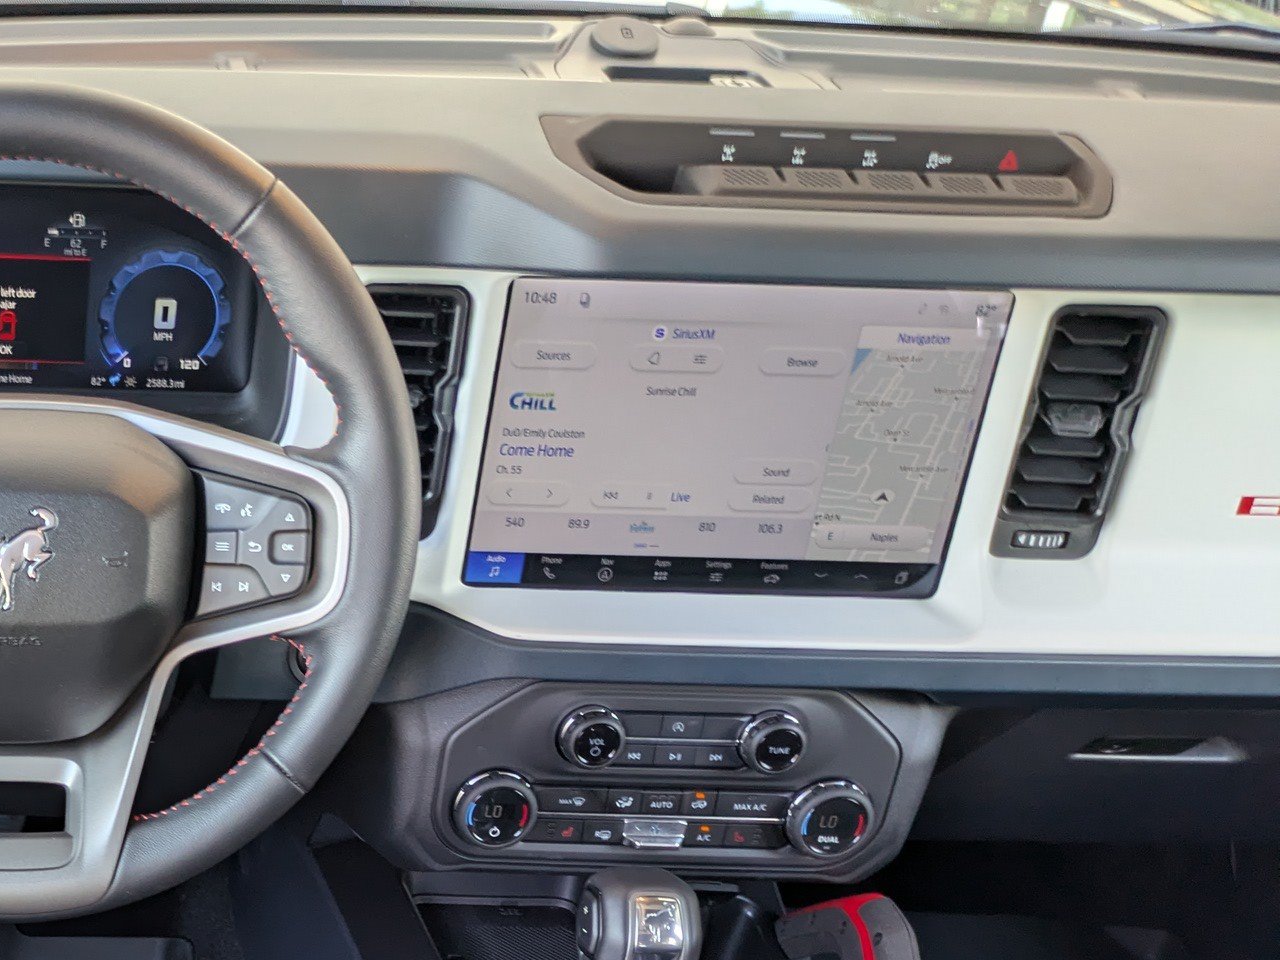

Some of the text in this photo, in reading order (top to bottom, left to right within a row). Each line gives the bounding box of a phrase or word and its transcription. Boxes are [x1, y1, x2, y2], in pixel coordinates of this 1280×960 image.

[44, 237, 51, 248] E
[100, 239, 108, 250] F
[0, 286, 15, 298] left
[16, 286, 37, 299] door
[524, 291, 557, 304] 10:48
[0, 300, 17, 310] ajar
[153, 298, 177, 330] 0
[153, 331, 173, 341] MPH
[672, 329, 716, 340] SiriusXM
[897, 332, 951, 346] Navigation
[0, 345, 13, 355] OK
[536, 350, 572, 361] Sources
[123, 358, 132, 368] 0
[180, 359, 200, 370] 120
[786, 357, 818, 368] Browse
[9, 373, 33, 384] Home
[646, 387, 697, 397] Sunrise Chill
[509, 392, 557, 411] CHILL
[499, 443, 575, 458] Come Home
[511, 465, 522, 475] 55
[762, 467, 790, 477] Sound
[671, 493, 691, 503] Live
[752, 494, 784, 504] Related
[505, 518, 525, 528] 540
[568, 519, 590, 529] 89.9
[698, 522, 716, 532] 810
[758, 523, 783, 534] 106.3
[827, 532, 834, 541] E
[870, 532, 898, 544] Naples
[486, 555, 506, 563] Audio
[541, 556, 563, 565] Phone
[601, 558, 615, 566] Nav
[706, 560, 732, 570] Settings
[589, 738, 605, 746] VOL
[769, 747, 791, 755] TUNE
[650, 801, 673, 809] AUTO
[733, 803, 768, 812] MAX A/C
[696, 834, 711, 842] A/C
[817, 835, 839, 844] DUAL
